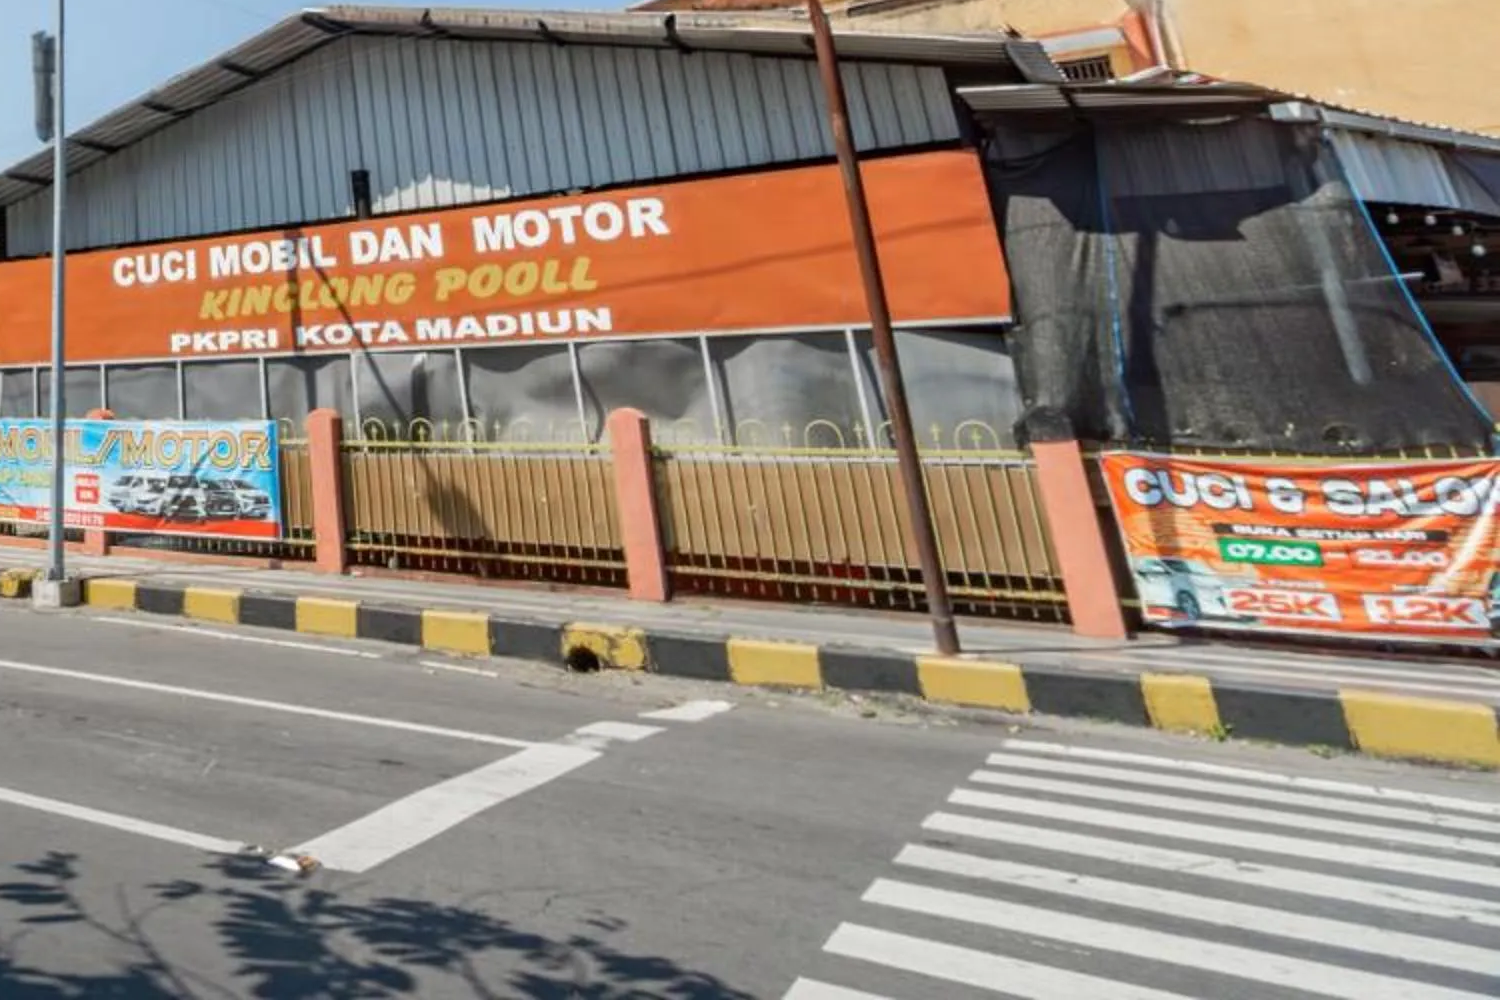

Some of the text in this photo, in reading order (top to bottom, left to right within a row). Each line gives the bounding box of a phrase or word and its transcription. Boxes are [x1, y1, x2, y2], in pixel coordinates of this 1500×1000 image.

[113, 197, 671, 287] CUCI MOBIL DAN MOTOR
[434, 256, 598, 302] POOLL
[170, 307, 613, 353] PKPRI KOTA MADIUN
[1123, 467, 1253, 511] CUCI
[1264, 477, 1305, 514] &
[1227, 543, 1317, 562] 07.00
[1231, 591, 1335, 617] 25K
